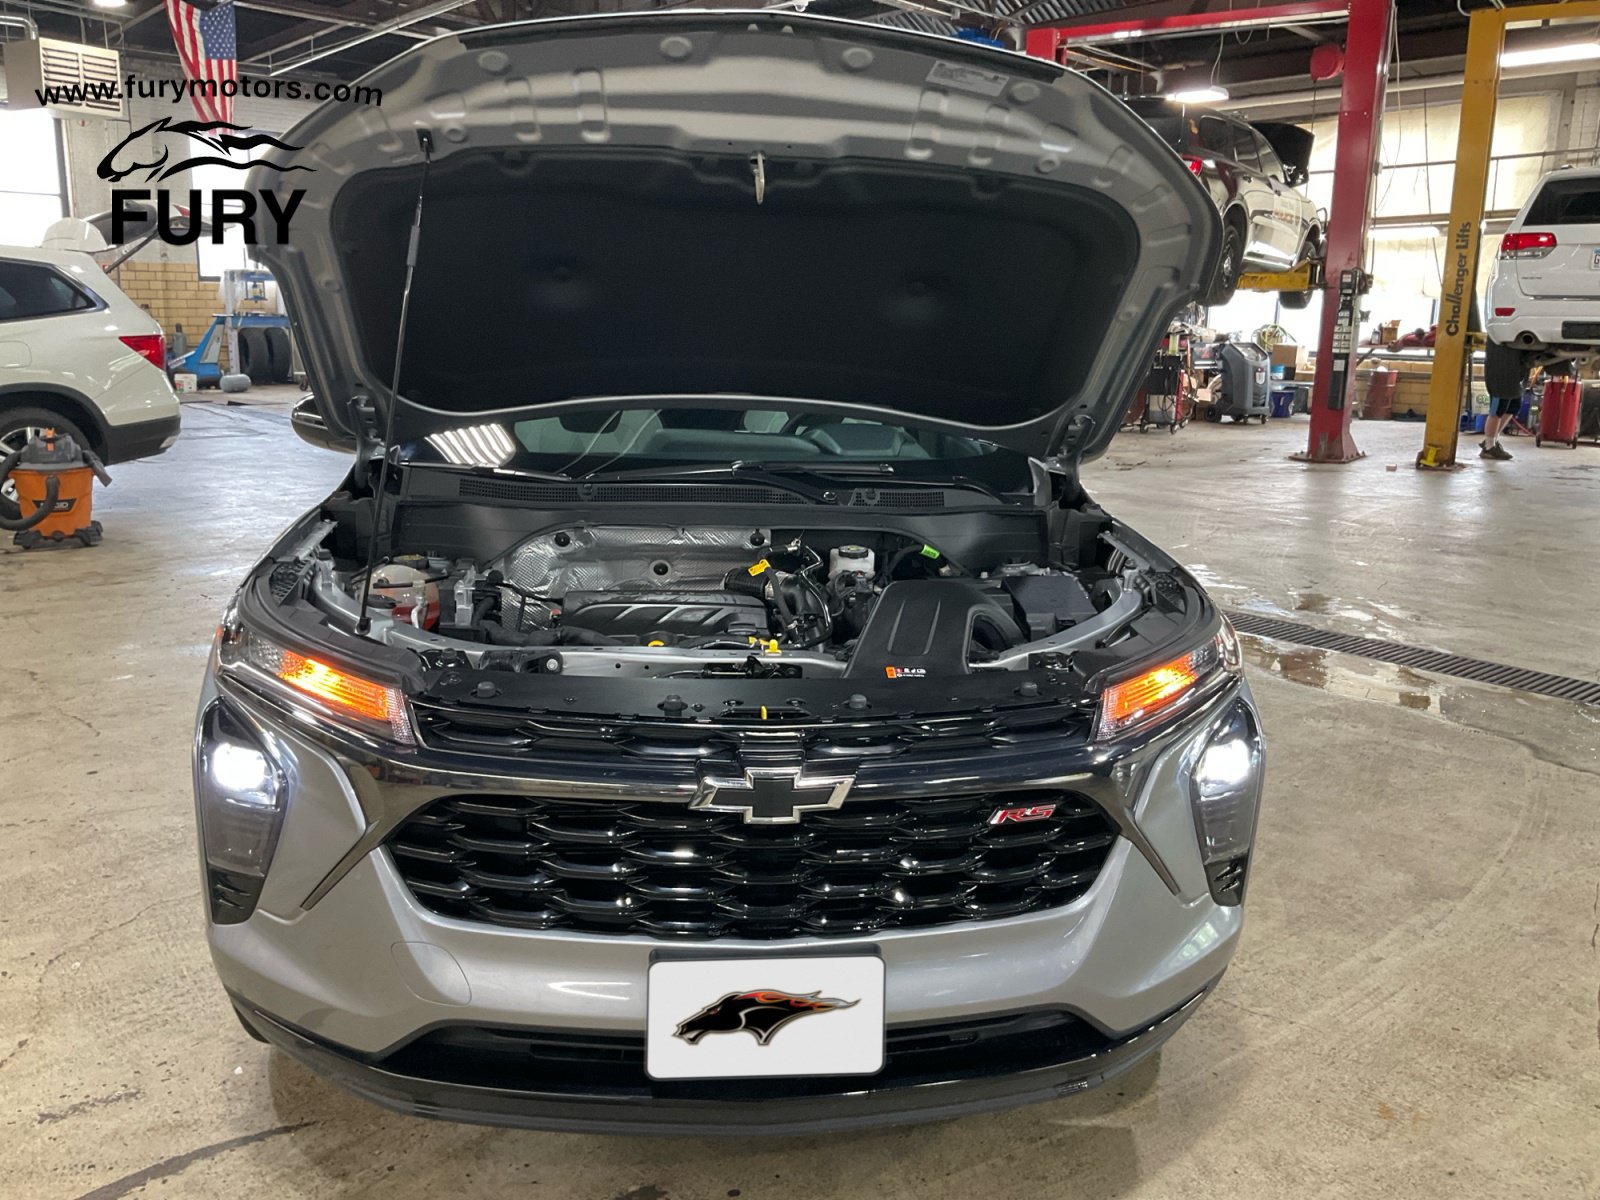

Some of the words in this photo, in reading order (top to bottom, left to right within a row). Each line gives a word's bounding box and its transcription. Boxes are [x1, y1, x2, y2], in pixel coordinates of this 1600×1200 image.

[1456, 221, 1471, 250] Lifts
[1445, 252, 1469, 336] Challenger
[990, 804, 1056, 825] RS
